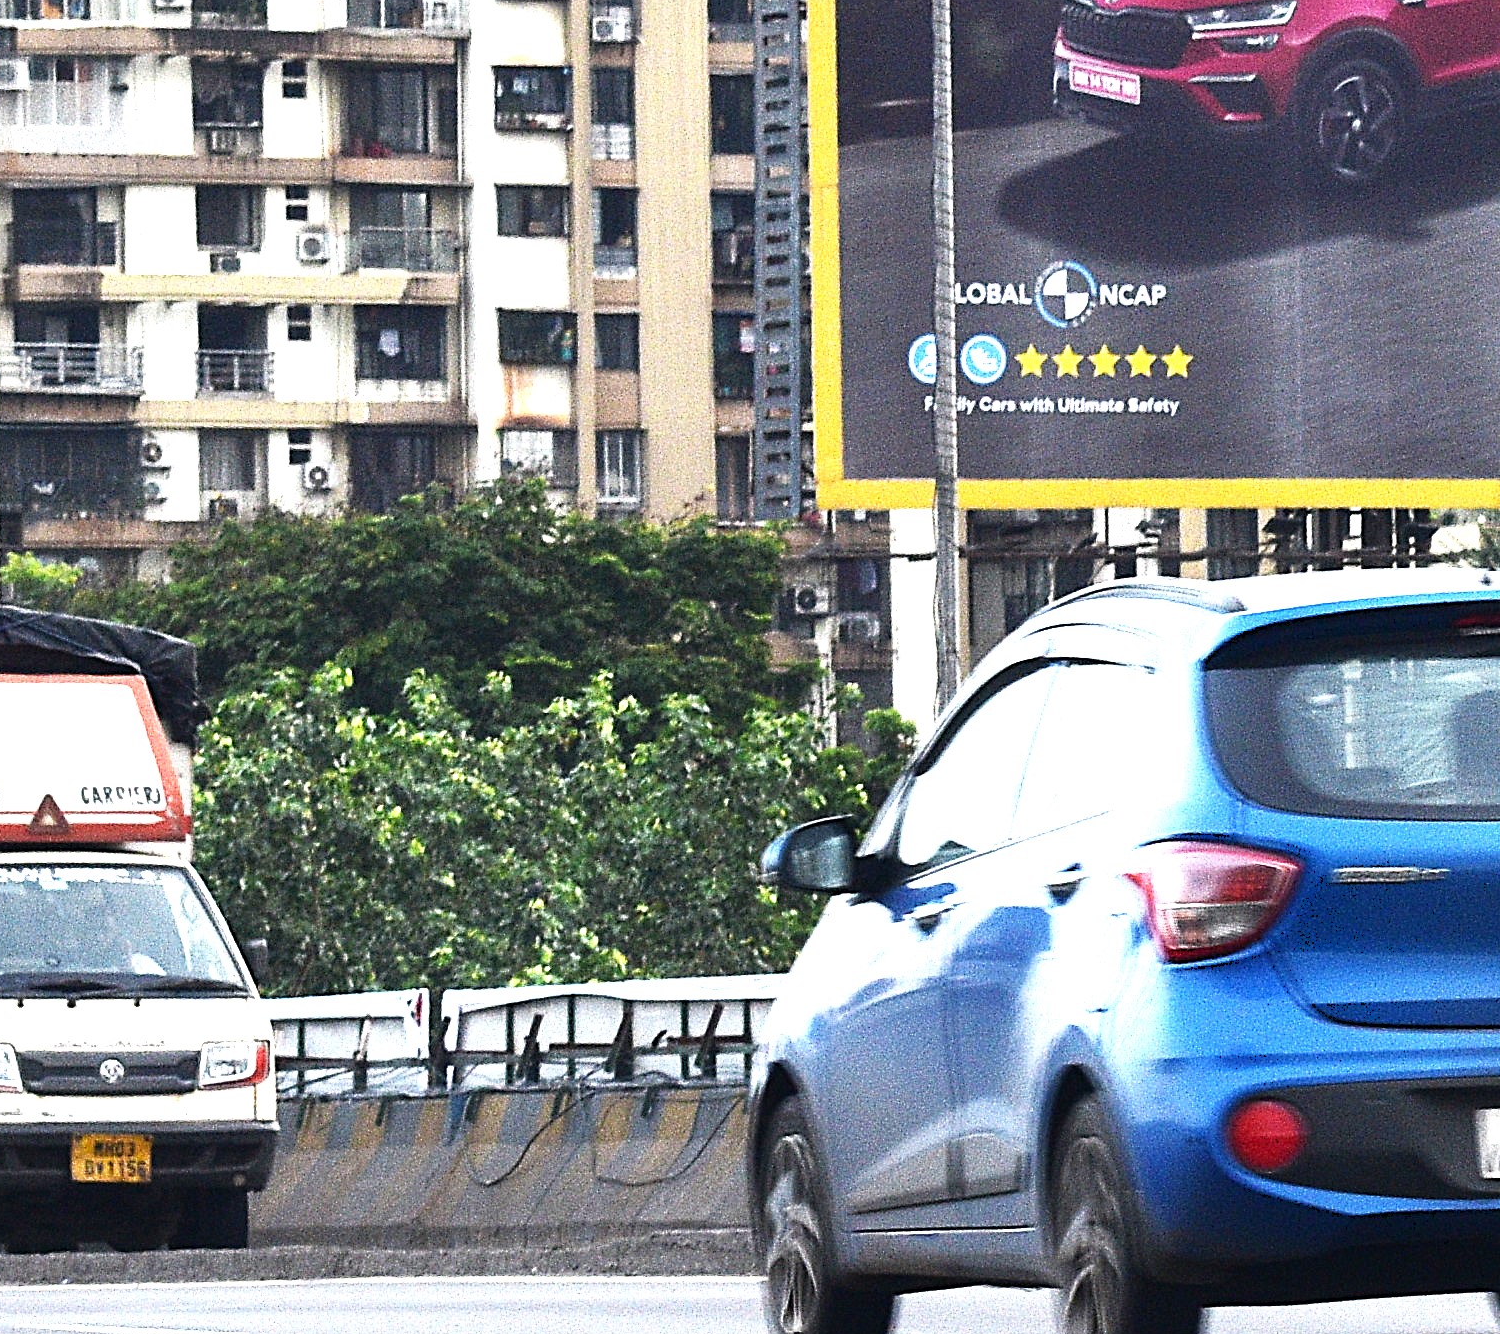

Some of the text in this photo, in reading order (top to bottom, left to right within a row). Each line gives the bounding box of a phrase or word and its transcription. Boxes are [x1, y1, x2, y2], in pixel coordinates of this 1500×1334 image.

[954, 283, 1167, 306] LOBAL NCAP
[979, 396, 1016, 412] Cars
[1020, 396, 1054, 413] with
[1058, 397, 1124, 413] Ultimate
[1128, 398, 1180, 416] Safety
